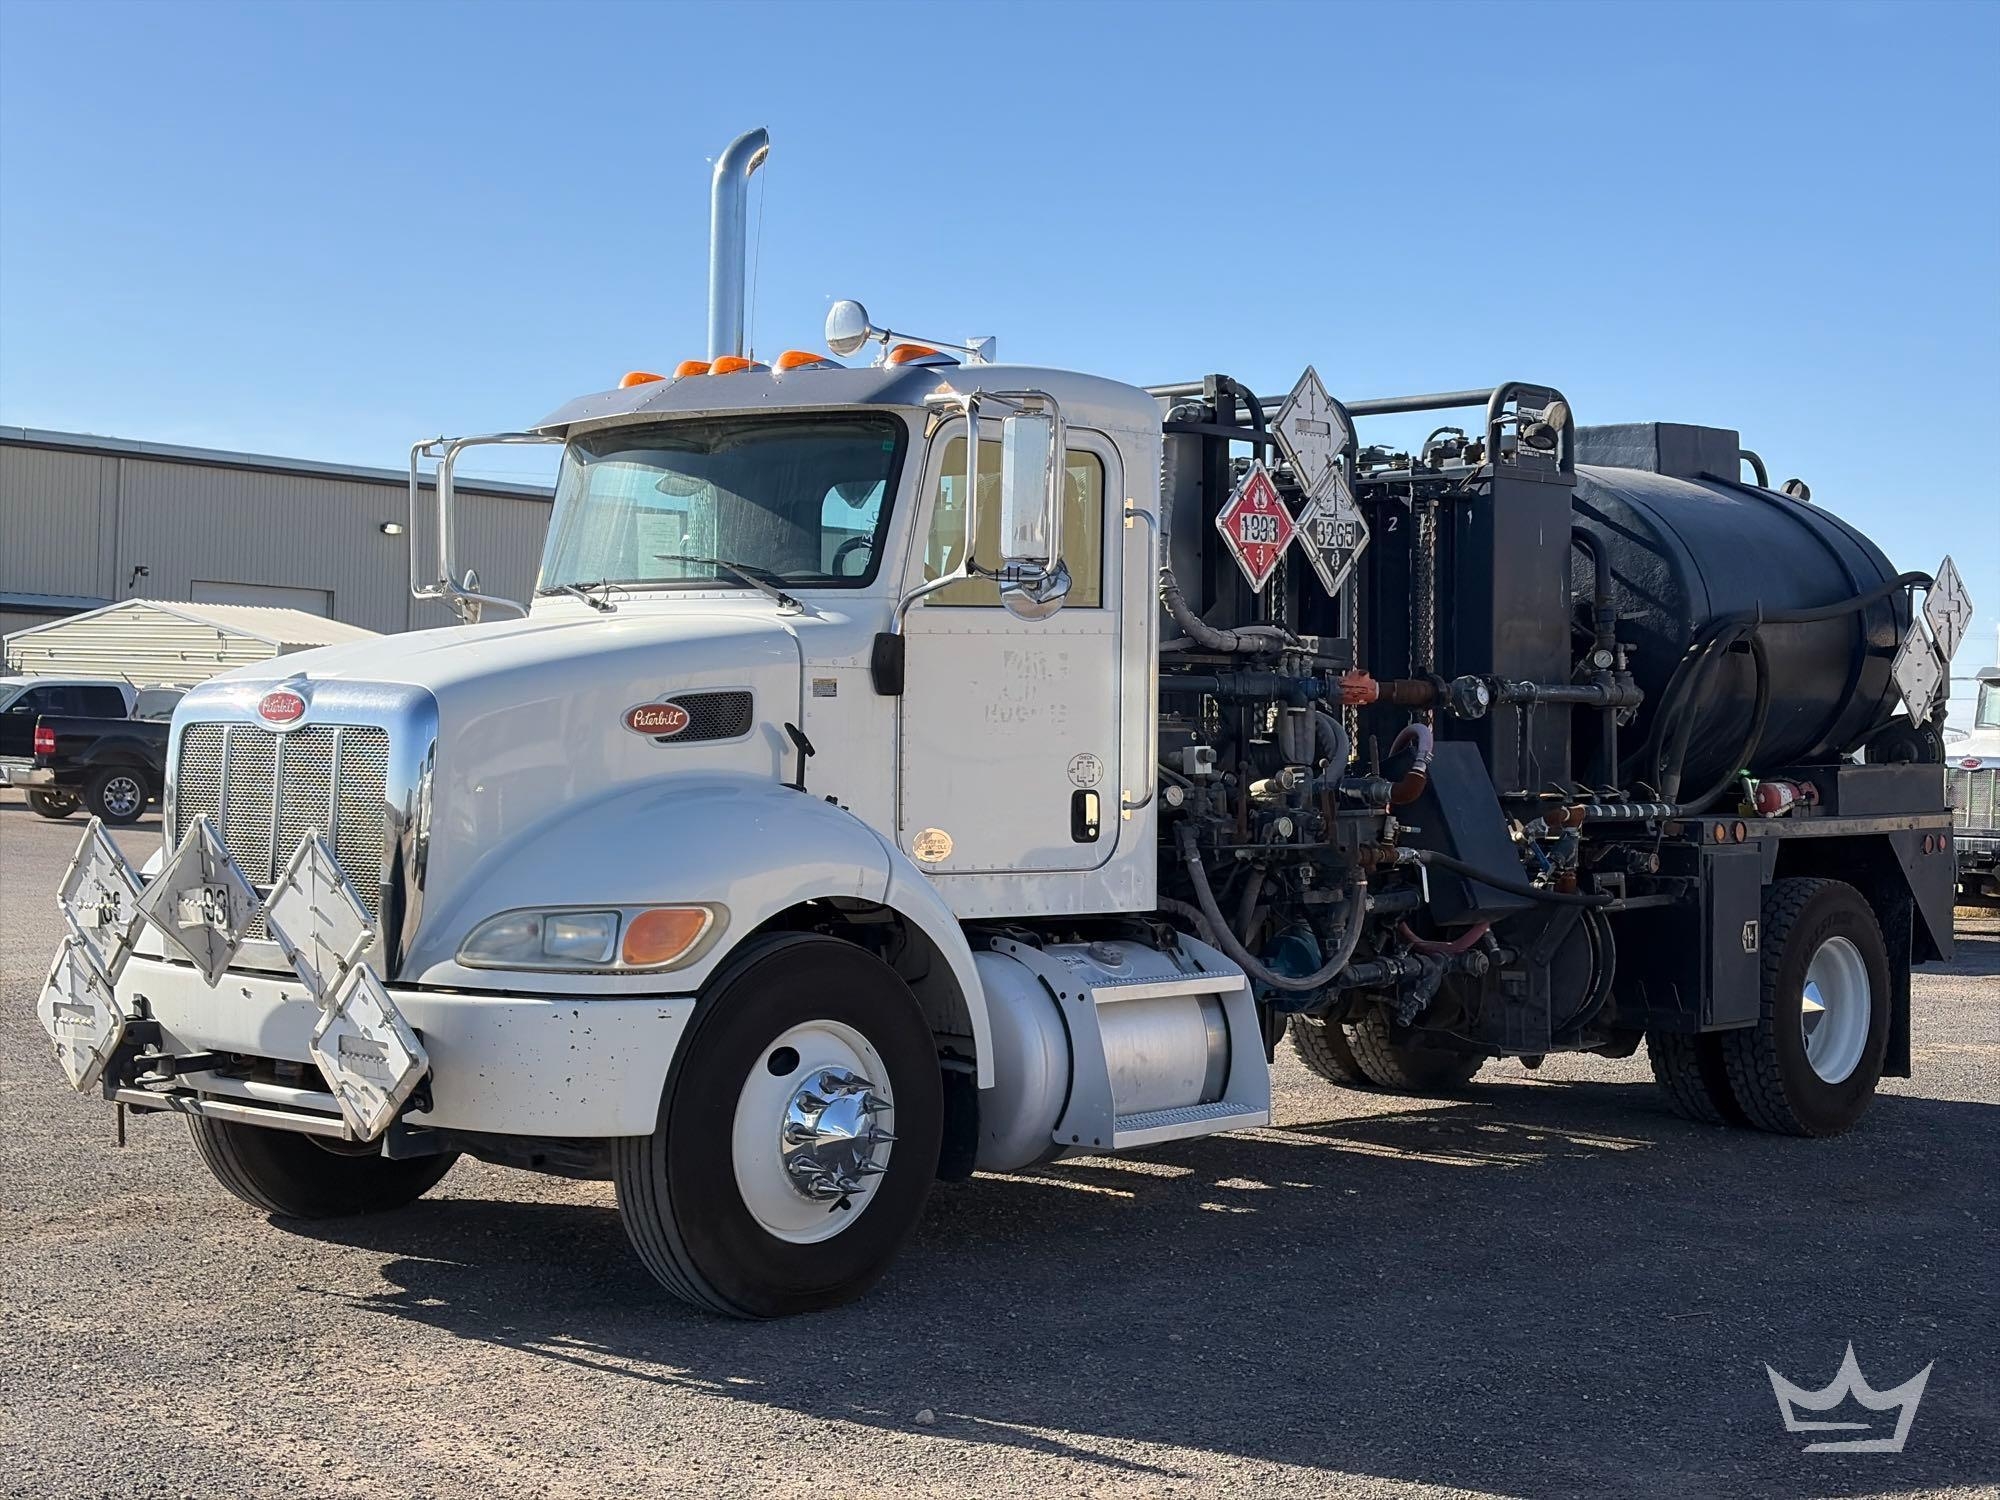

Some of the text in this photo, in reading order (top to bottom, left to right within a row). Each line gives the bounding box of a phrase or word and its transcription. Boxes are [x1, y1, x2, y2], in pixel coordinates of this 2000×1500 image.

[1242, 515, 1277, 543] 1993
[1317, 520, 1354, 547] 3265
[1387, 516, 1398, 532] 2
[1256, 546, 1264, 566] 3
[634, 709, 683, 728] Peterbilt
[203, 887, 227, 925] 93
